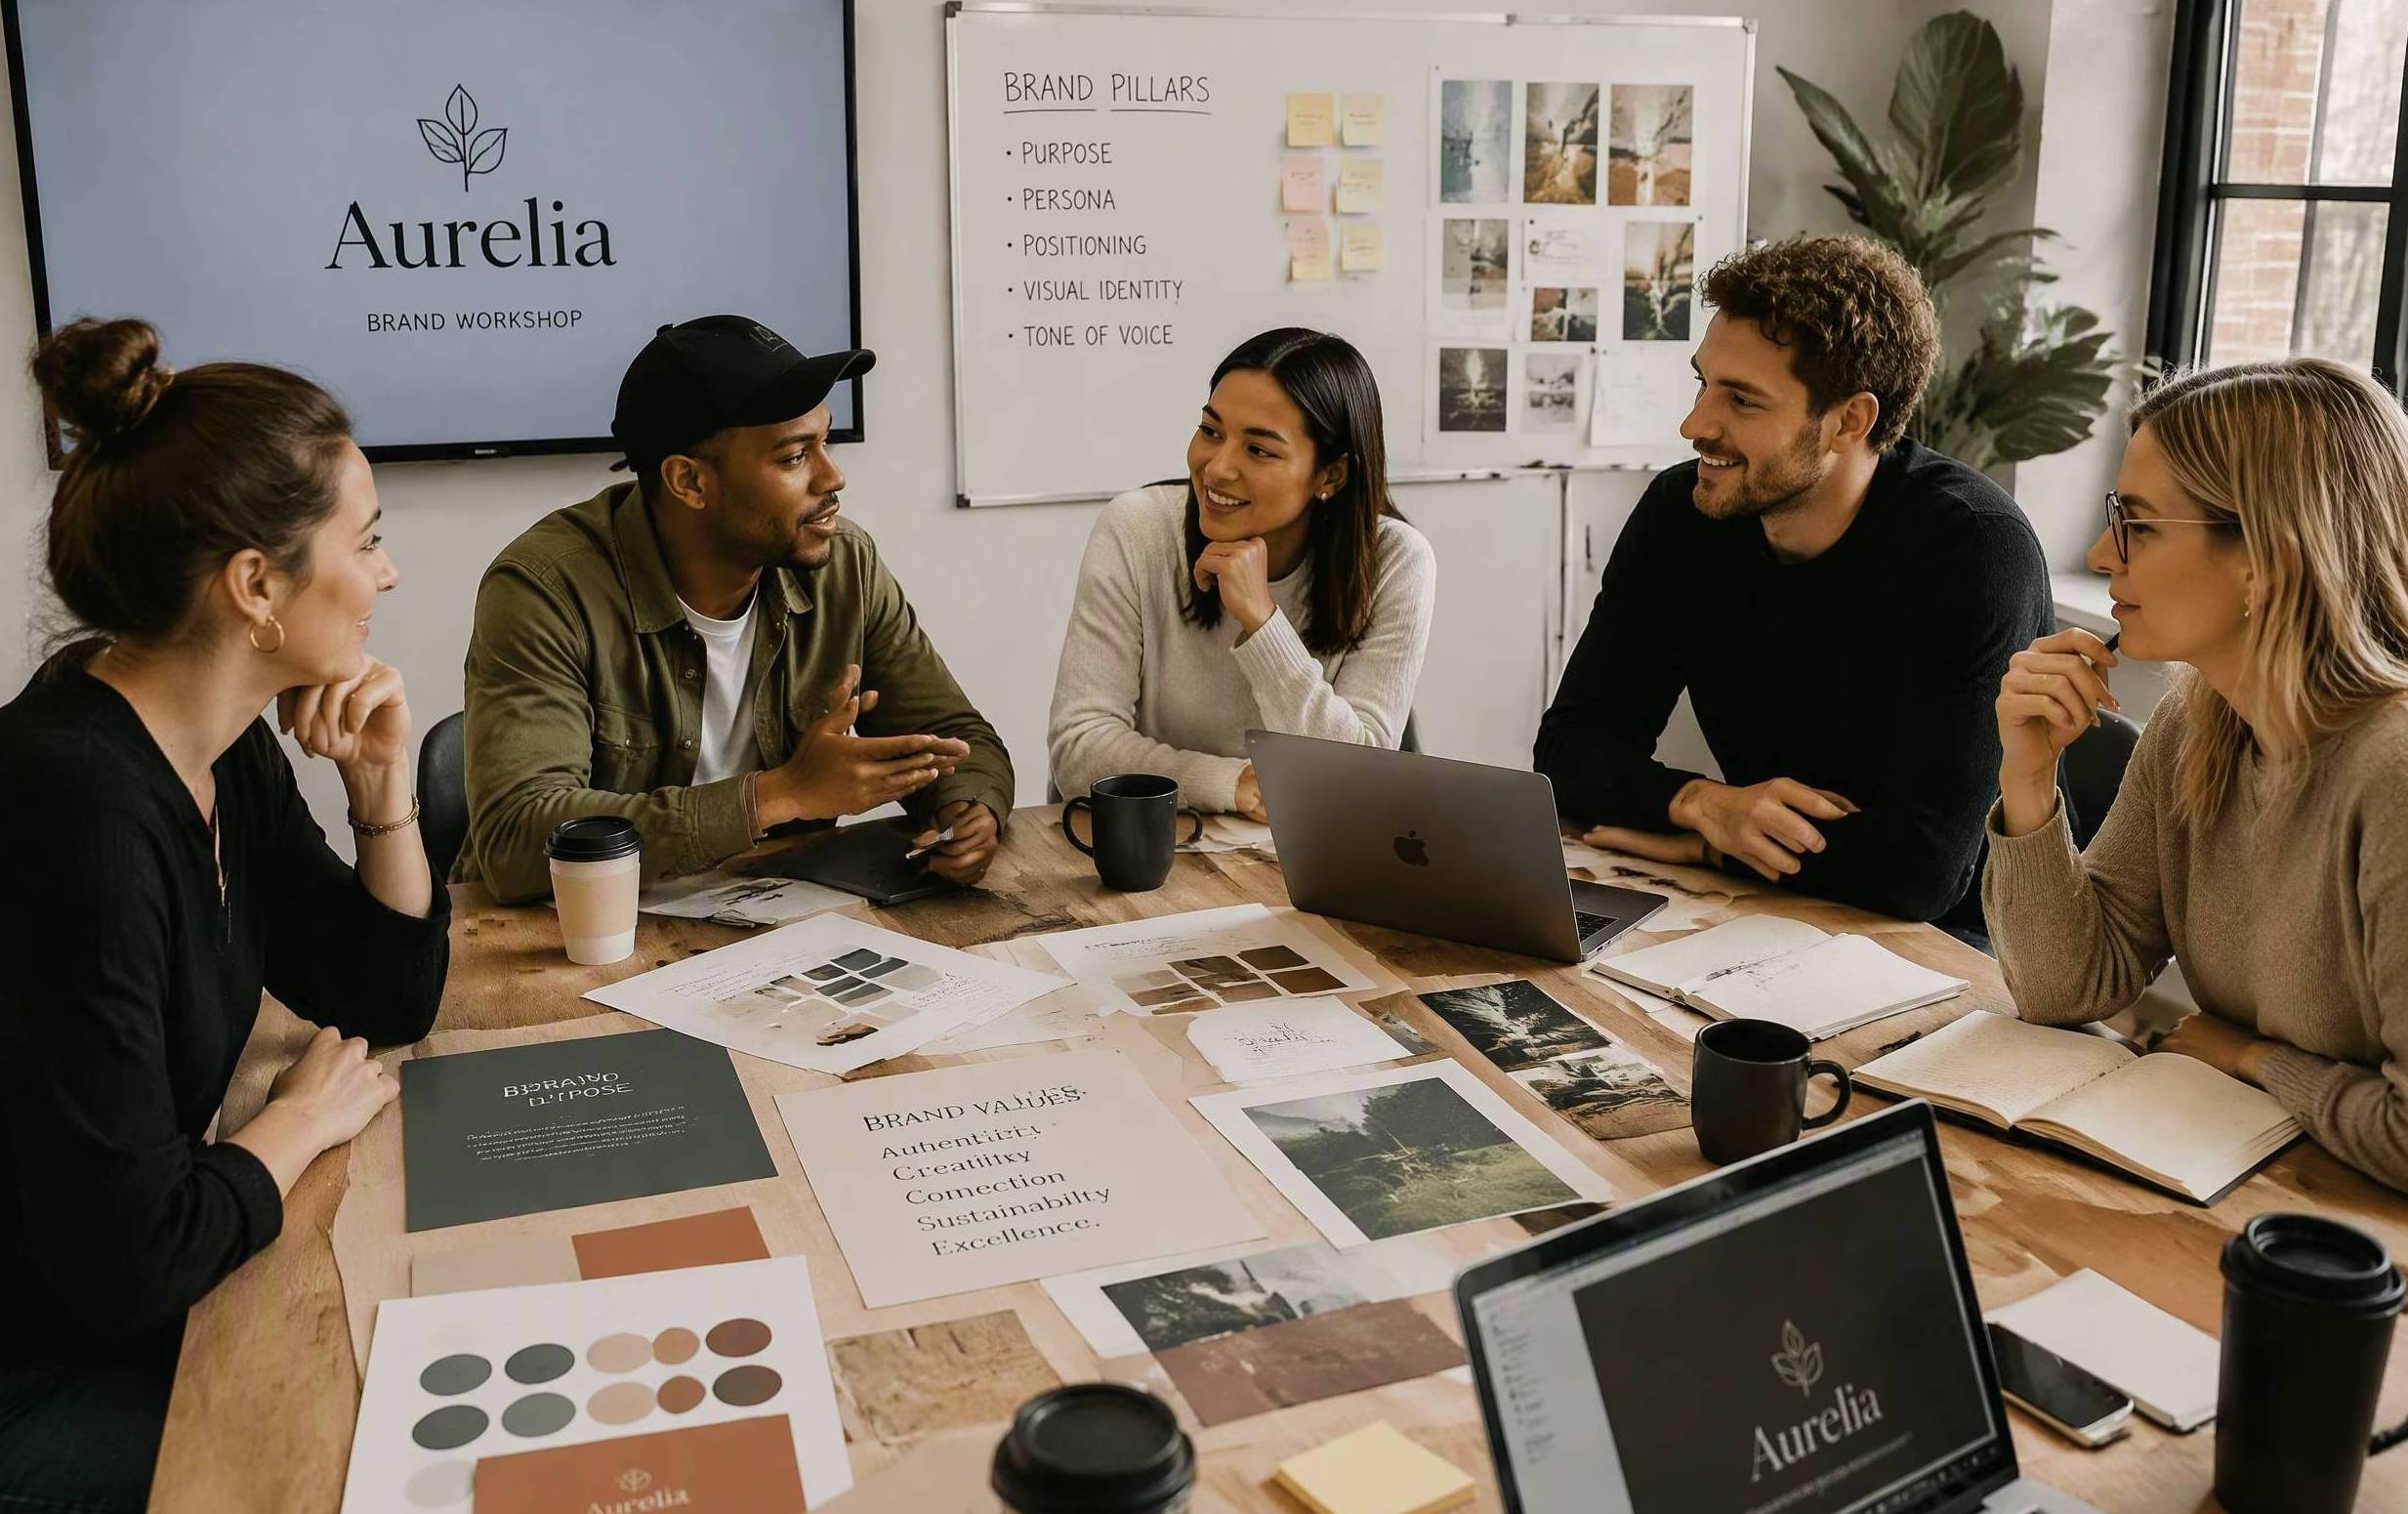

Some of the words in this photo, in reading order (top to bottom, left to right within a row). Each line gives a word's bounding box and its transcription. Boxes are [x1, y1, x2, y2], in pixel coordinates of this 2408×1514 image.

[1005, 72, 1094, 103] BRAND
[1111, 74, 1210, 103] PILLARS
[1021, 141, 1113, 165] PURPOSE
[1022, 188, 1116, 211] PERSONA
[324, 196, 617, 270] Aurelia
[1023, 233, 1146, 257] POSITIONING
[1023, 280, 1090, 302] VISUAL
[1100, 279, 1183, 301] IDENTITY
[367, 313, 446, 333] BRAND
[455, 310, 583, 331] WORKSHOP
[1022, 325, 1075, 347] TONE
[1085, 324, 1108, 346] OF
[1118, 324, 1174, 346] VOICE
[863, 1105, 965, 1132] BRAND
[1751, 1382, 1885, 1484] Aurelia
